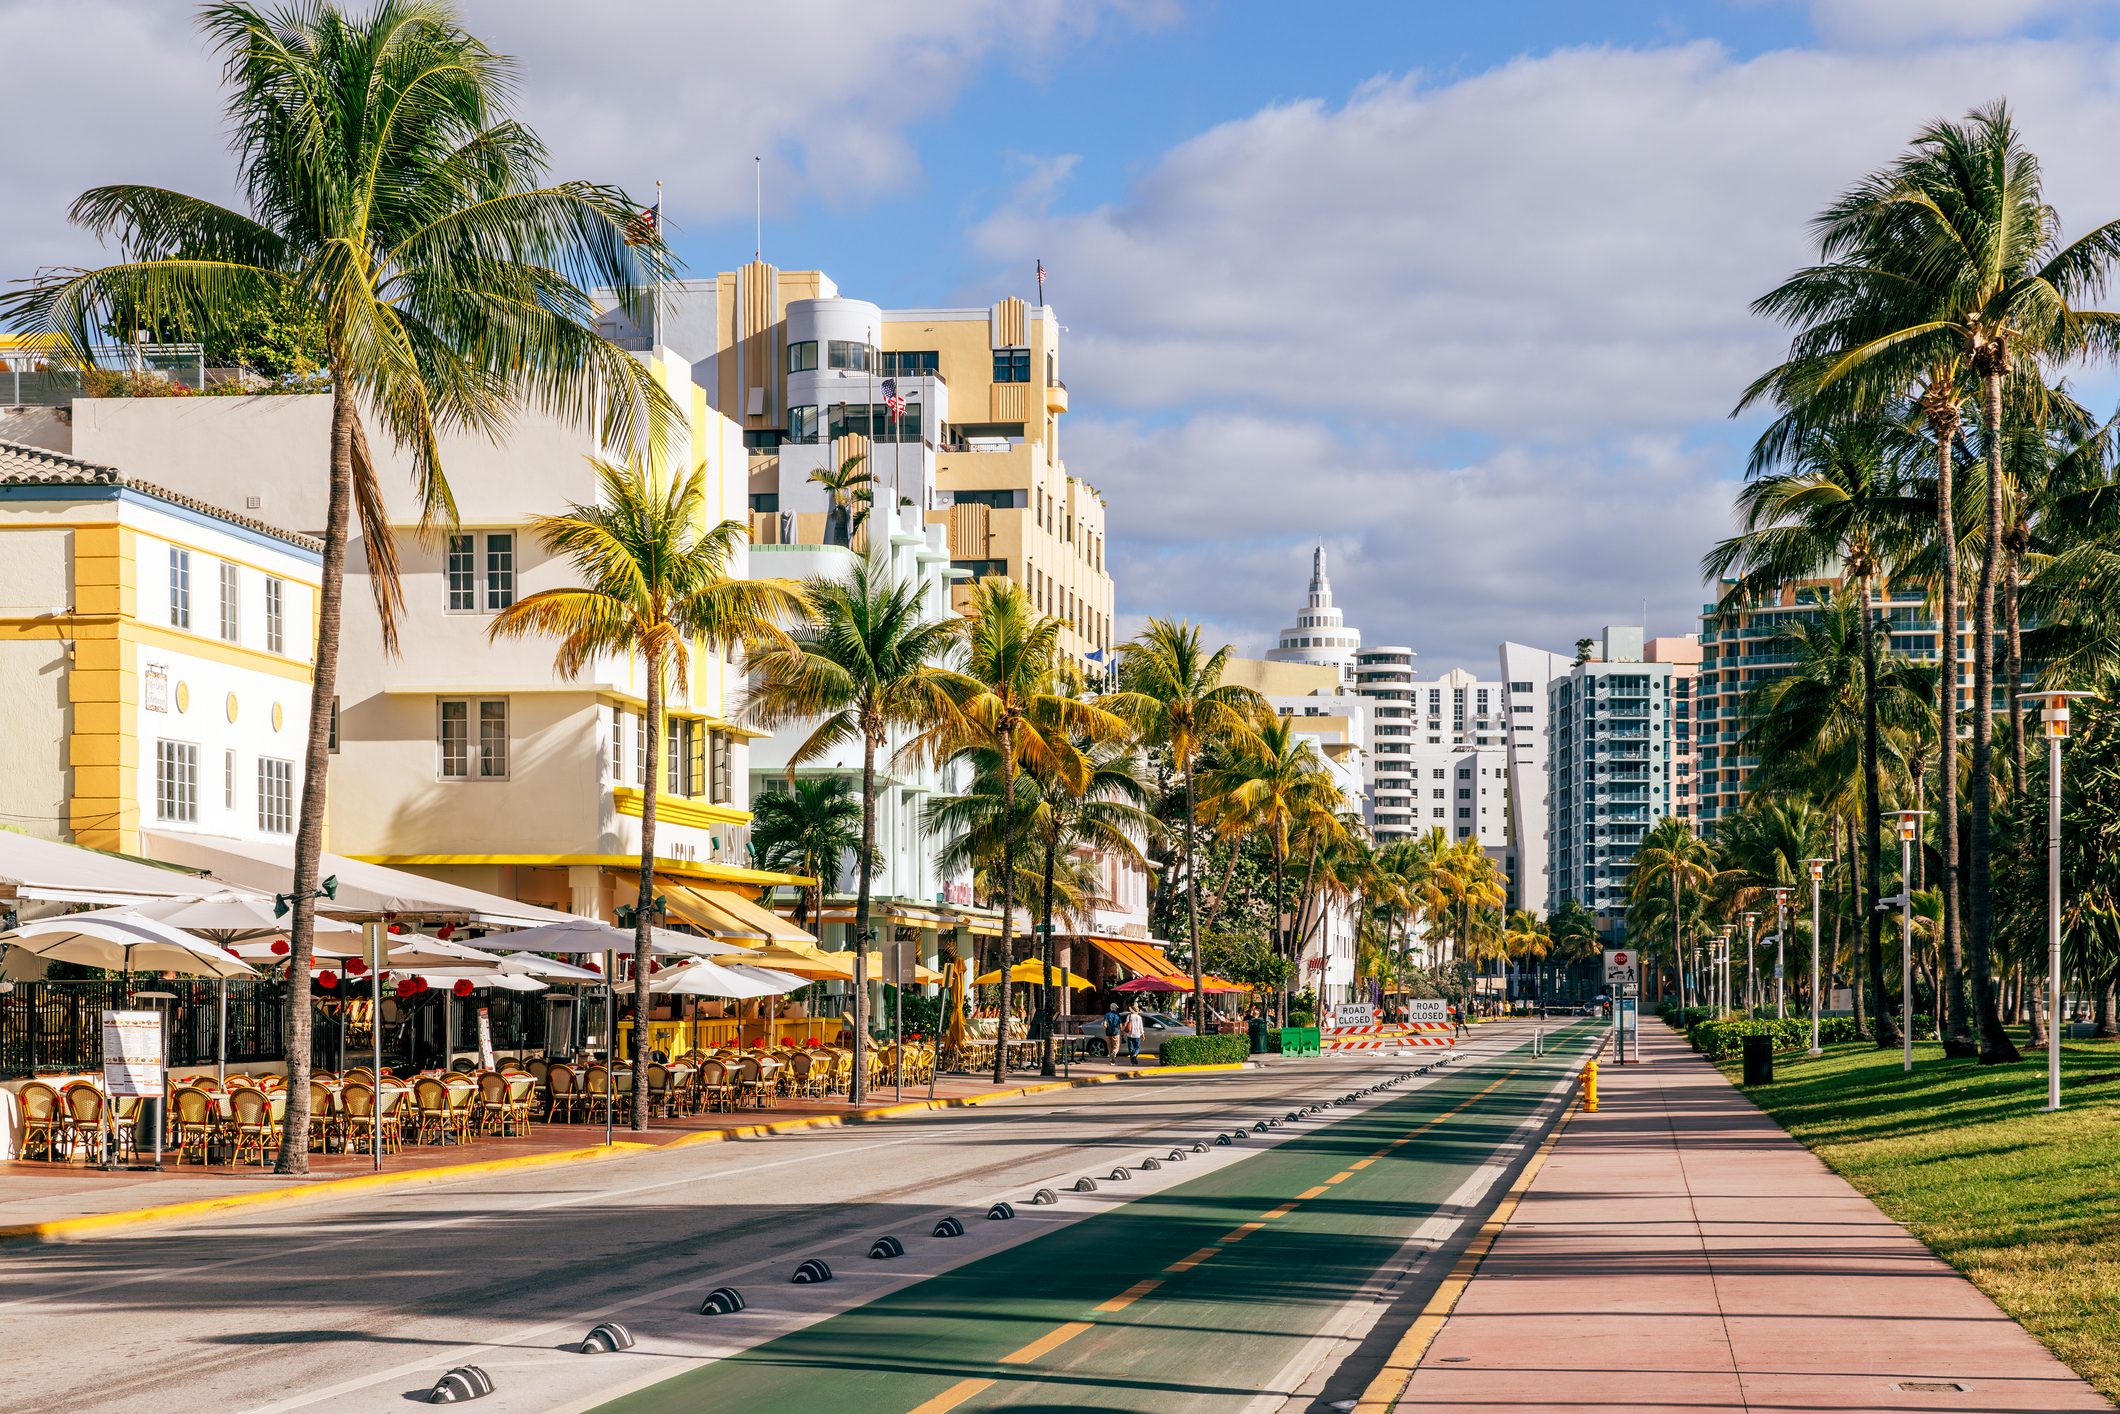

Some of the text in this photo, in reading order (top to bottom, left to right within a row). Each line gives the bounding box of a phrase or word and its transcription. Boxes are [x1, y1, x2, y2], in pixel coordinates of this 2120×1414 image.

[1416, 1002, 1439, 1010] ROAD
[1339, 1015, 1370, 1025] CLOSED
[1412, 1012, 1444, 1020] CLOSED
